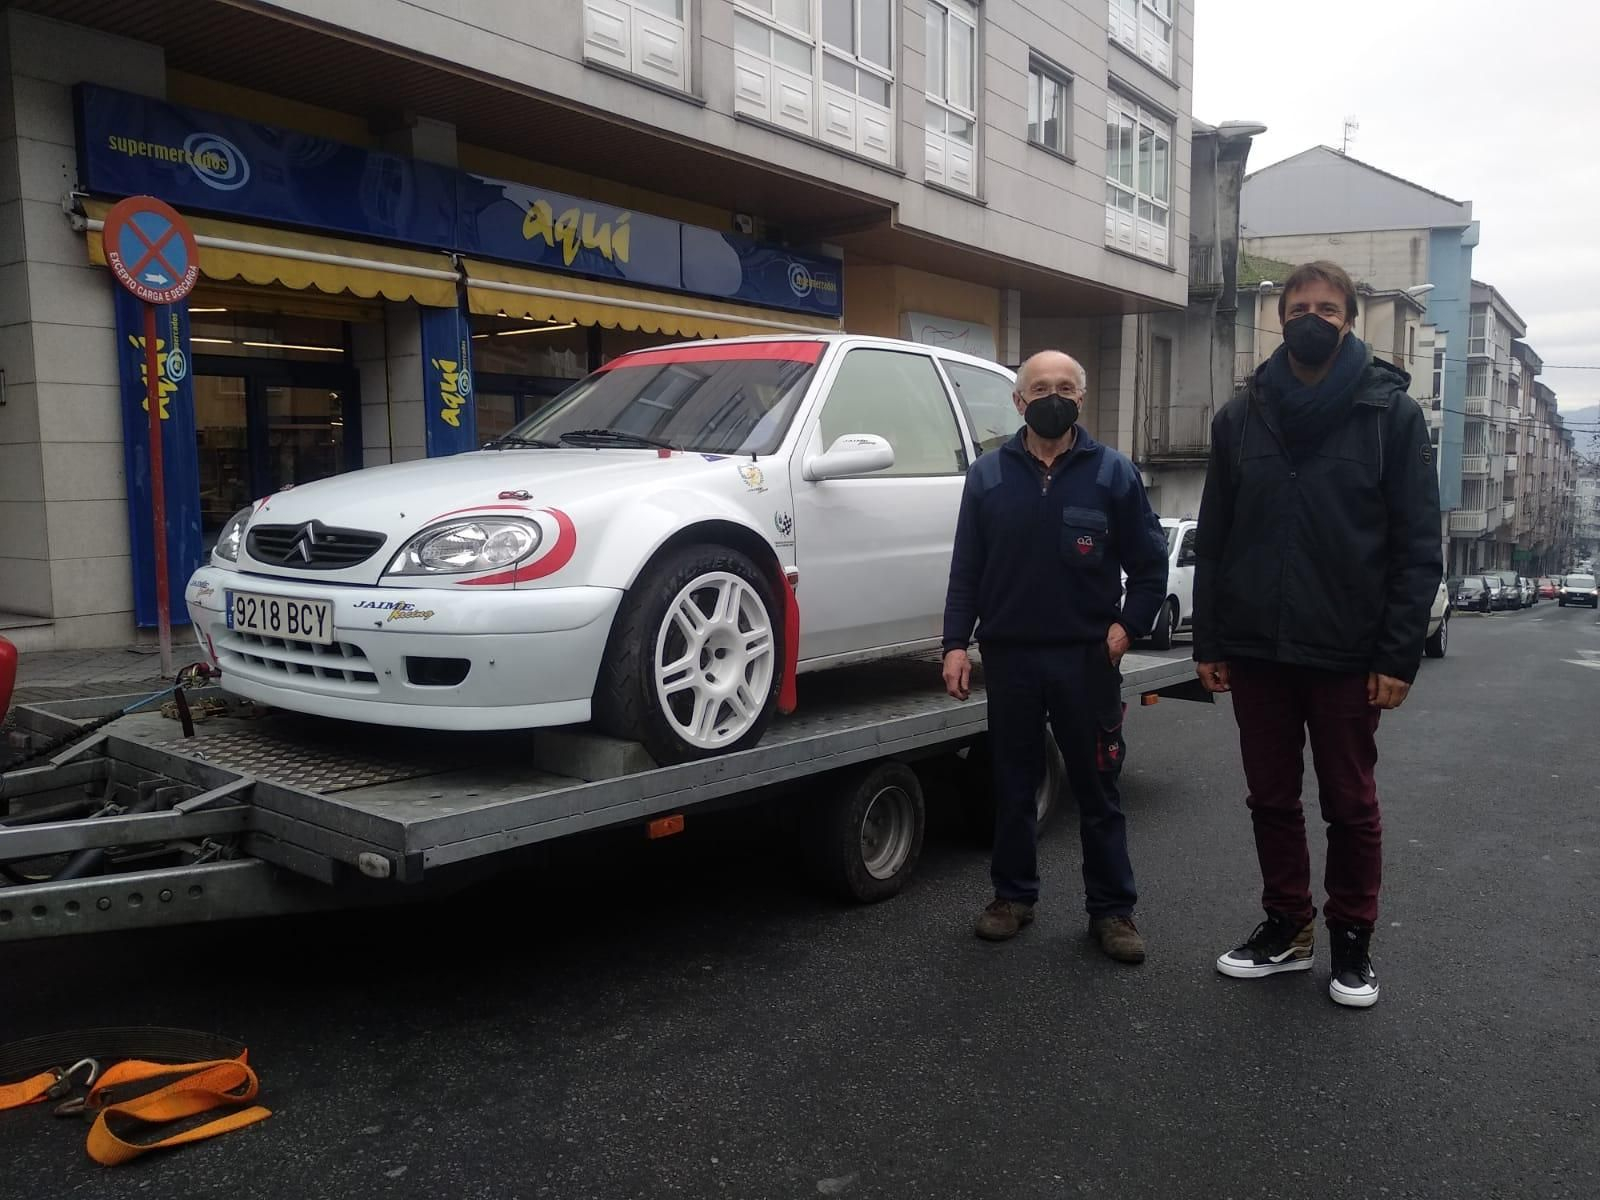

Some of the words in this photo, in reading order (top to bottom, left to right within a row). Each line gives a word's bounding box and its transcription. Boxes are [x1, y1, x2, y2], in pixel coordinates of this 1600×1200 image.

[108, 135, 228, 171] supermercados
[522, 199, 631, 267] aquí
[109, 252, 137, 289] EXCEPTO
[137, 286, 164, 302] CARGA
[165, 291, 172, 301] E
[171, 265, 198, 299] DESCARGA
[431, 358, 466, 427] aquí
[236, 597, 281, 632] 9218
[287, 602, 327, 638] BCY
[353, 601, 416, 611] JAIME
